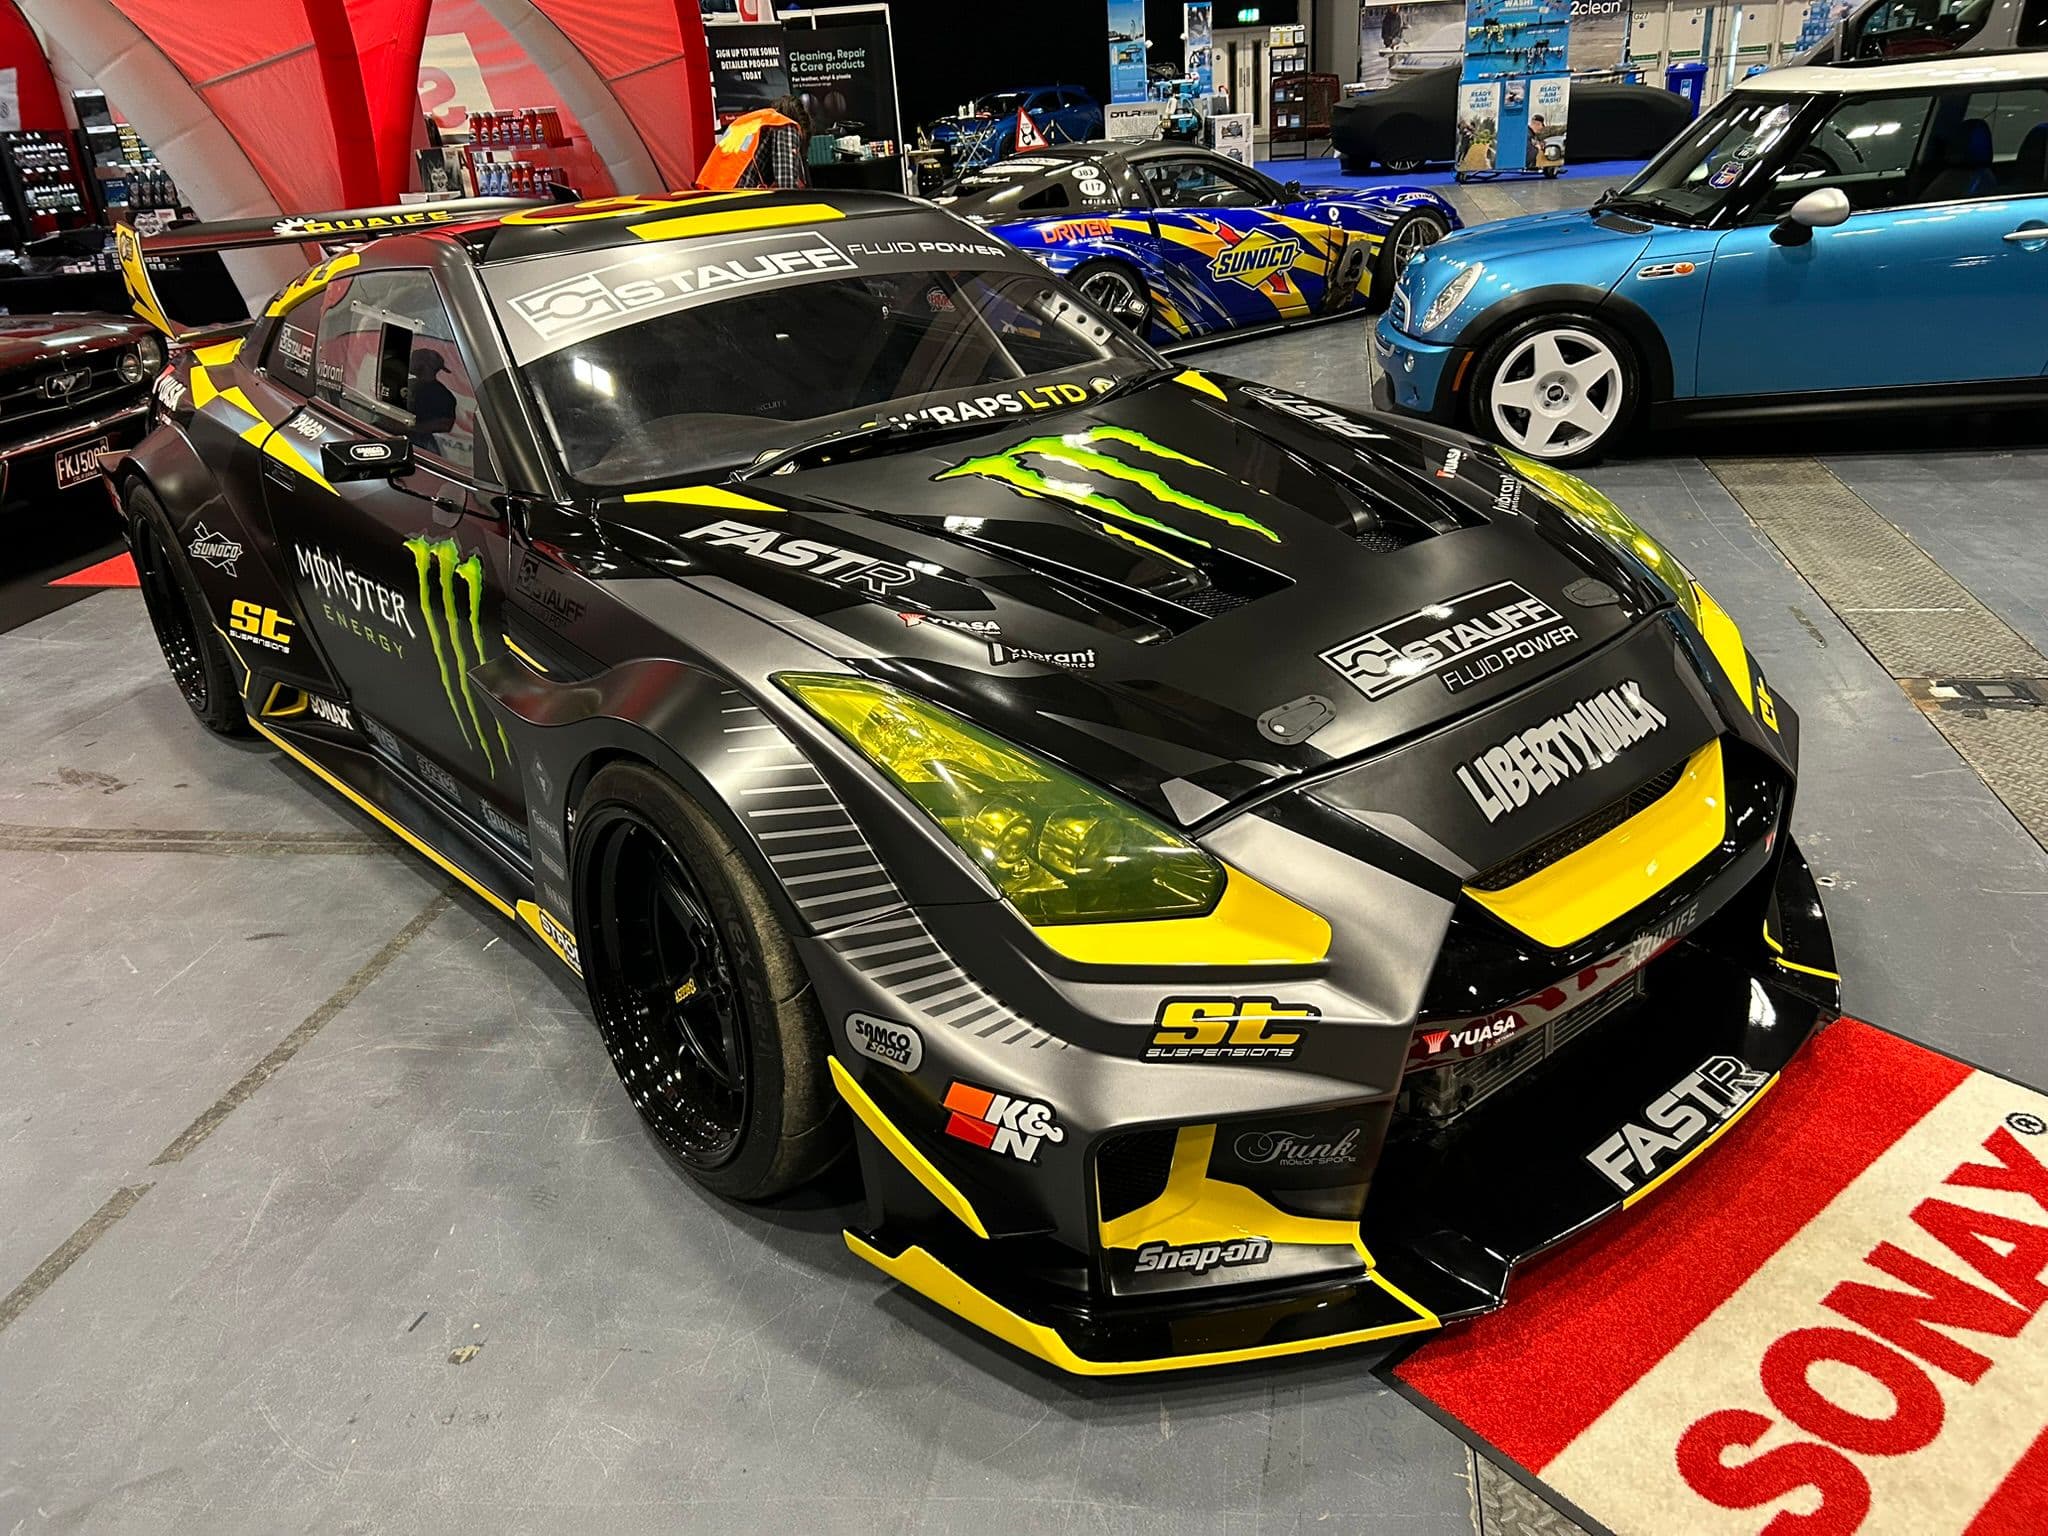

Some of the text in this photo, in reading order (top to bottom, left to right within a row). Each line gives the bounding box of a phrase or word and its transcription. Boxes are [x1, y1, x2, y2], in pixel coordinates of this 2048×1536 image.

[715, 48, 731, 58] SIGN
[731, 48, 740, 58] UP
[740, 48, 749, 57] TO
[720, 58, 779, 70] DETAILER PROGRAM
[789, 49, 866, 62] Cleaning, Repair
[790, 59, 865, 72] & Care products
[742, 71, 762, 80] TODAY
[303, 210, 454, 233] QUAIFE
[1040, 218, 1113, 244] DRIVEN
[613, 241, 1006, 307] STAUFF FLUID POWER
[1217, 244, 1293, 274] SUNOCO
[193, 543, 240, 559] SUNOCO
[323, 604, 404, 659] ENERGY
[1400, 598, 1547, 665] STAUFF
[1442, 624, 1579, 692] FLUID POWER
[854, 1019, 912, 1051] SAMCO
[1450, 1015, 1517, 1049] YUASA
[1233, 1127, 1361, 1165] Funk
[1134, 1240, 1268, 1272] Snap-on
